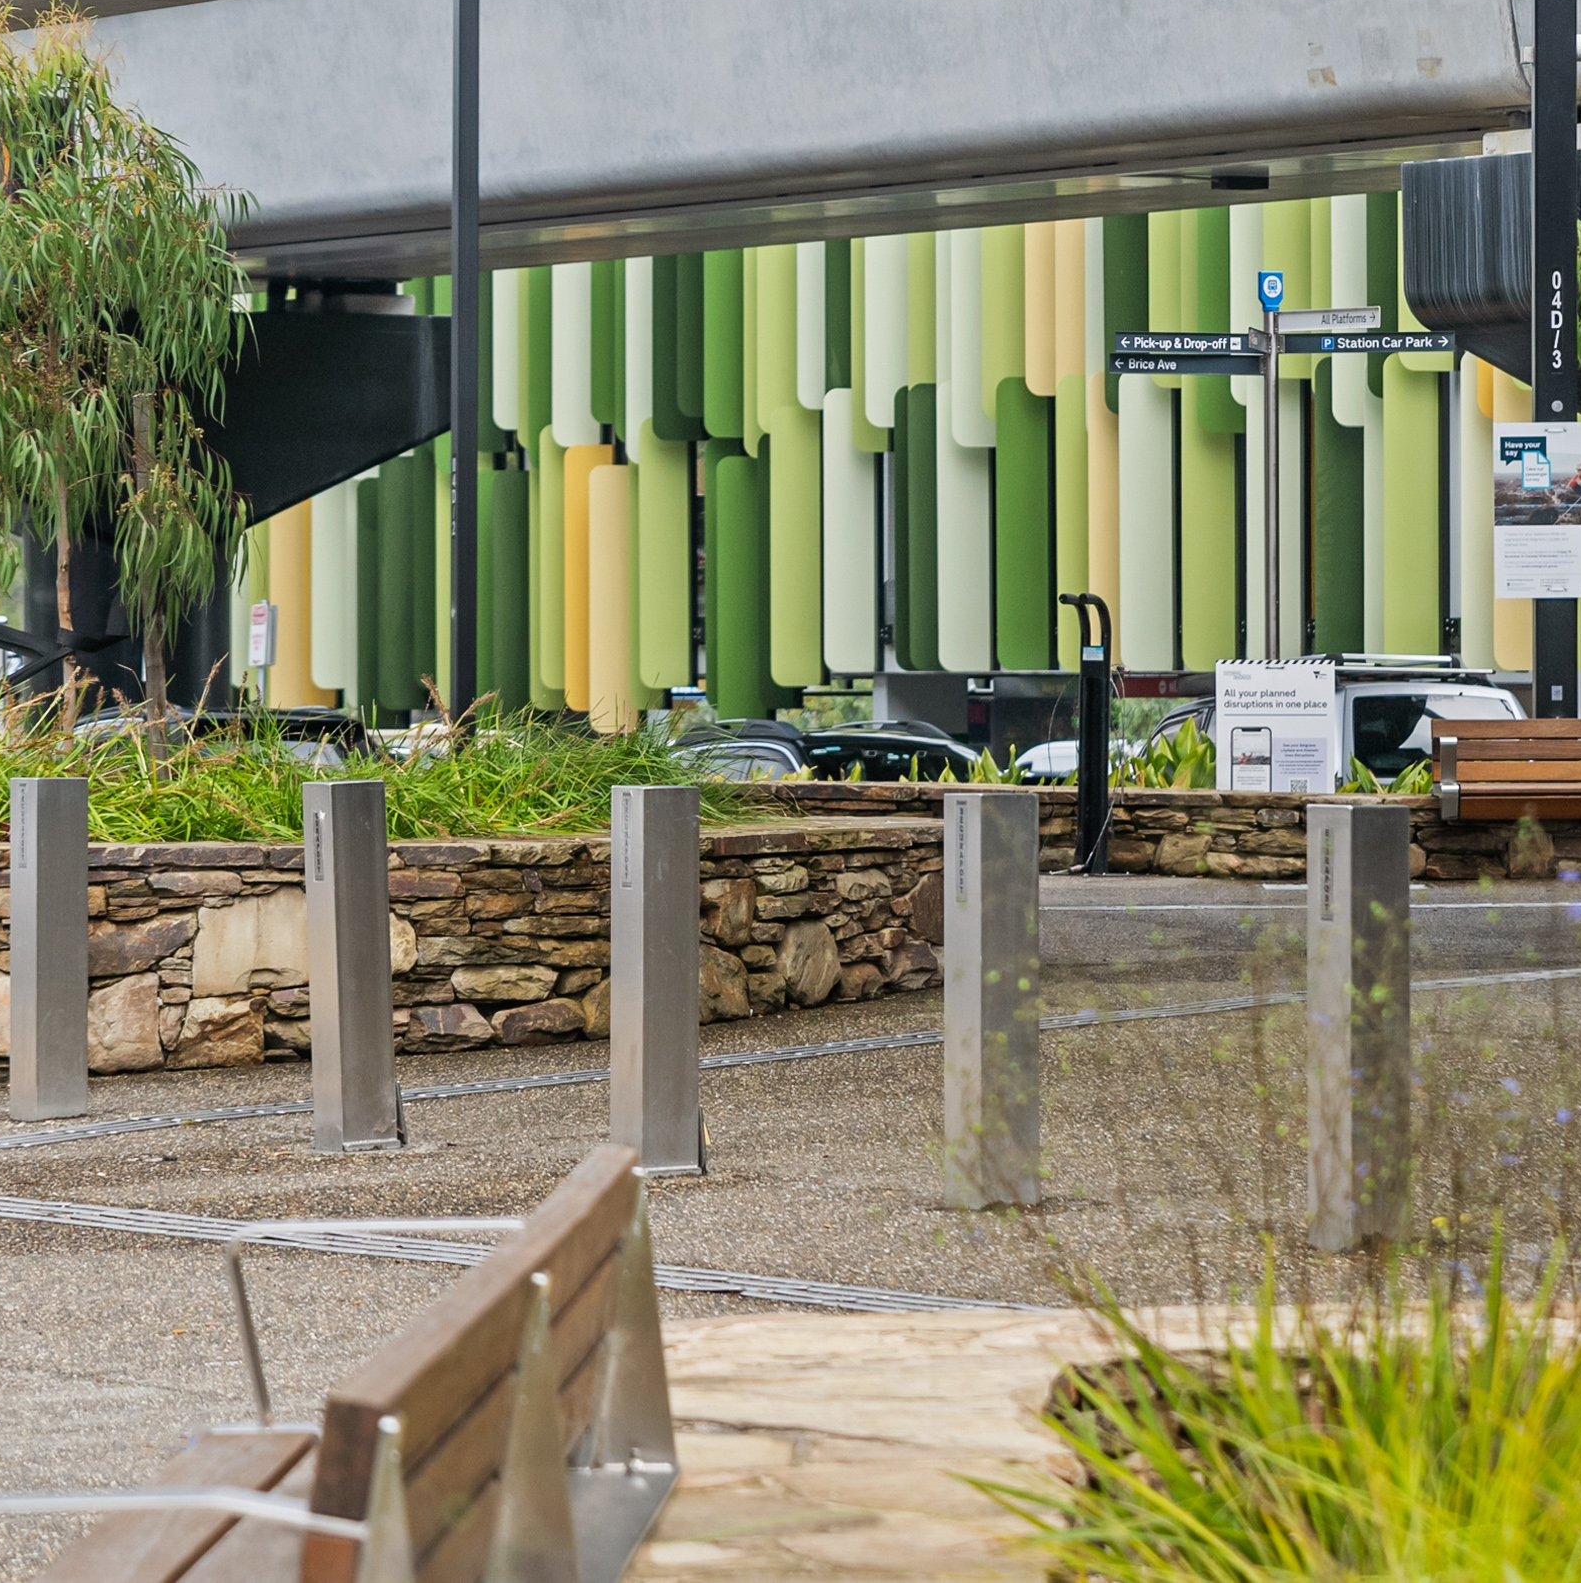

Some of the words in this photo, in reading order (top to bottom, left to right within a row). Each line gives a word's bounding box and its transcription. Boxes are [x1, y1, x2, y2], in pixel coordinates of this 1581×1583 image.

[1321, 314, 1330, 325] All
[1332, 313, 1367, 324] Platforms
[1550, 271, 1563, 369] 04D/3
[1134, 337, 1172, 351] Pick-up
[1174, 337, 1182, 349] &
[1184, 337, 1228, 351] Drop-off
[1337, 338, 1380, 349] Station
[1382, 337, 1403, 348] Car
[1405, 336, 1433, 348] Park
[1128, 358, 1155, 370] Brice
[1157, 359, 1177, 370] Ave
[1504, 441, 1523, 449] Have
[1224, 689, 1236, 698] All
[1238, 690, 1258, 699] your
[1260, 689, 1296, 700] planned
[1224, 700, 1273, 709] disruptions
[1276, 700, 1284, 708] in
[1303, 700, 1328, 709] place
